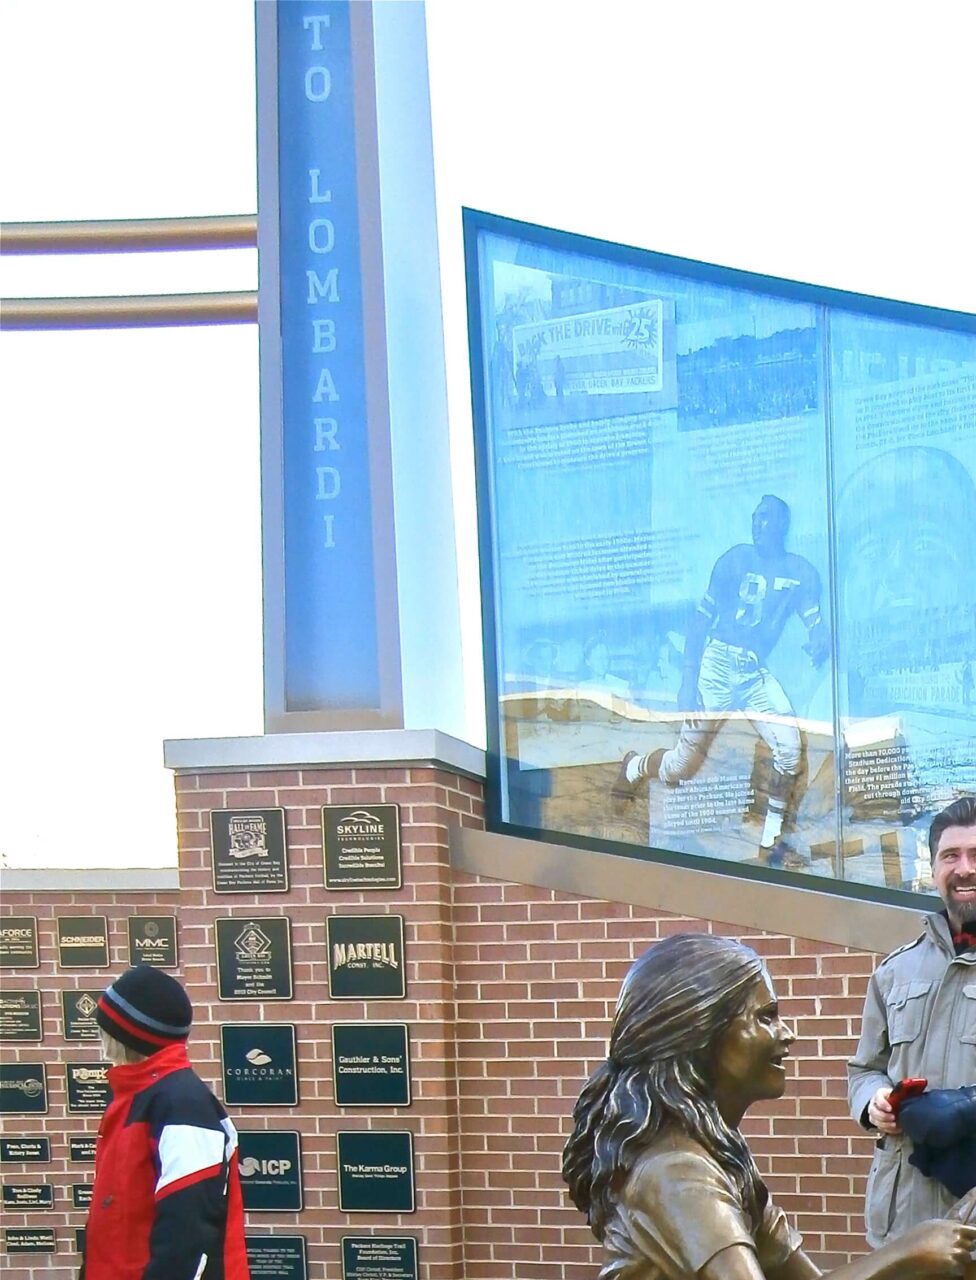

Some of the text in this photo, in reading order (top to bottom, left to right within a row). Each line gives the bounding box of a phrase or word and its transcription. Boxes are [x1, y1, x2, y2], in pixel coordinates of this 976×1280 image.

[573, 317, 613, 337] DRIVE
[625, 316, 652, 342] 25
[306, 169, 342, 548] LOMBARDI
[337, 825, 385, 834] SKYLINE
[135, 939, 169, 947] MMC
[333, 943, 398, 970] MARTELL
[227, 1068, 292, 1076] CORCORAN
[261, 1160, 291, 1176] ICP
[344, 1164, 408, 1174] The Karma Group
